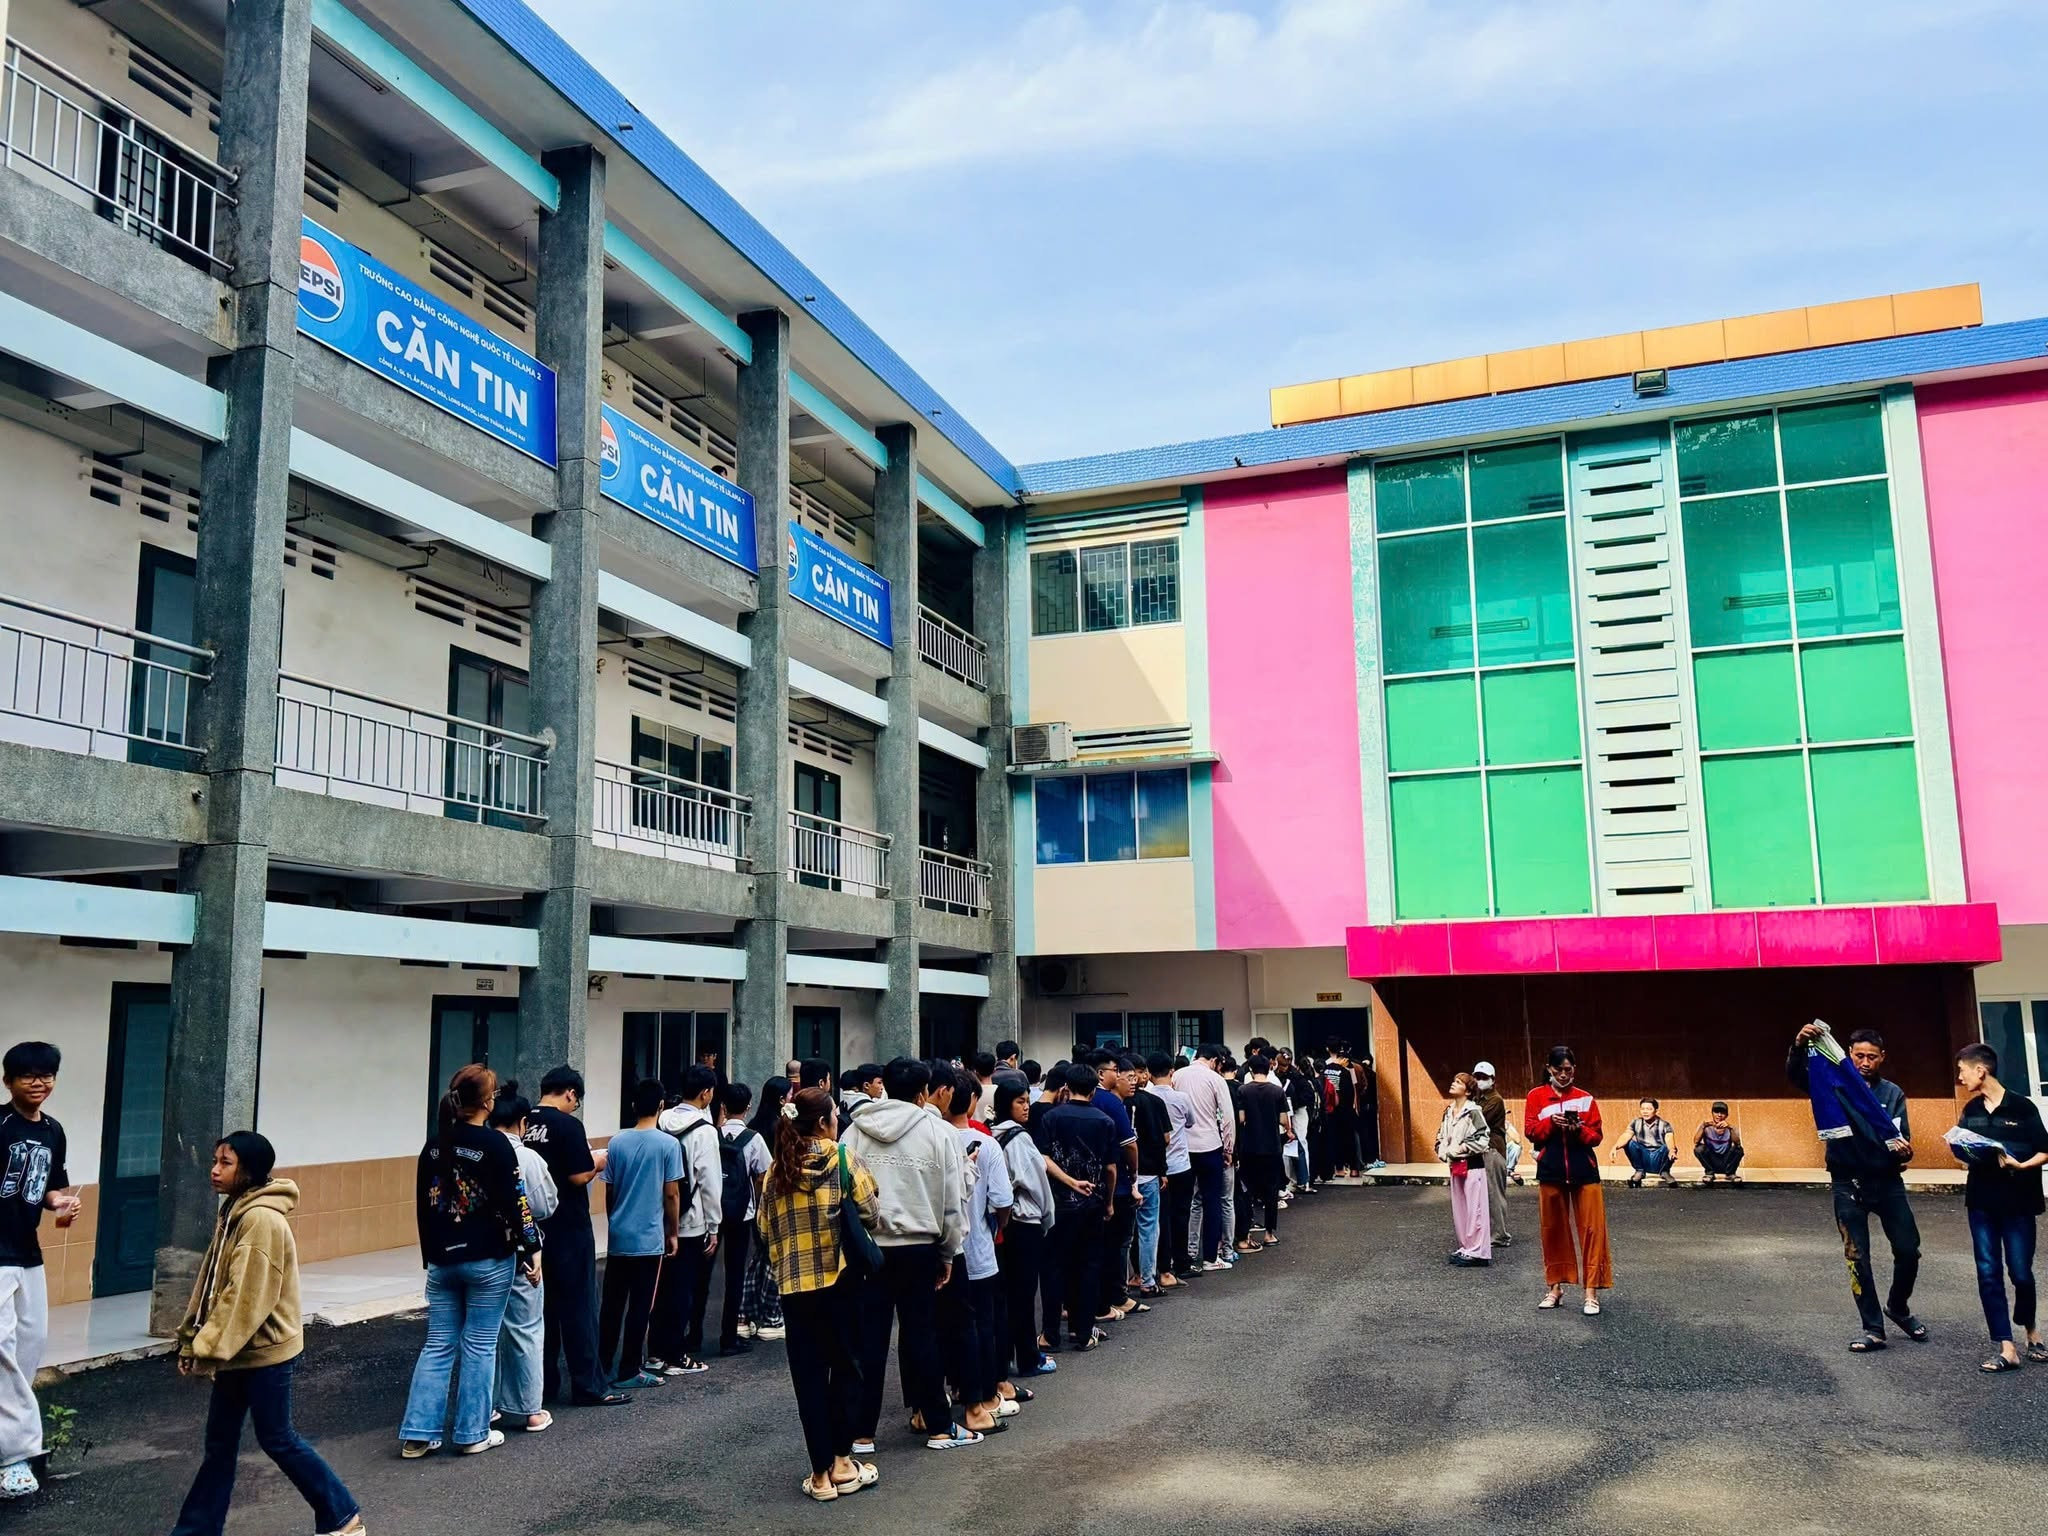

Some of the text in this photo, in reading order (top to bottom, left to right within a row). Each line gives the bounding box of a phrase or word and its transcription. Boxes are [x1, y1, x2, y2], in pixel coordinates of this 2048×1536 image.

[300, 264, 341, 301] EPSI
[358, 263, 542, 381] TRƯỜNG CAO ĐẲNG CÔNG NGHỆ QUỐC TẾ LILAMA 2
[376, 310, 528, 427] CĂN TIN
[600, 441, 618, 462] PSI
[641, 464, 695, 520] CĂN
[701, 495, 739, 545] TIN
[812, 564, 848, 608] CĂN
[852, 586, 879, 624] TIN
